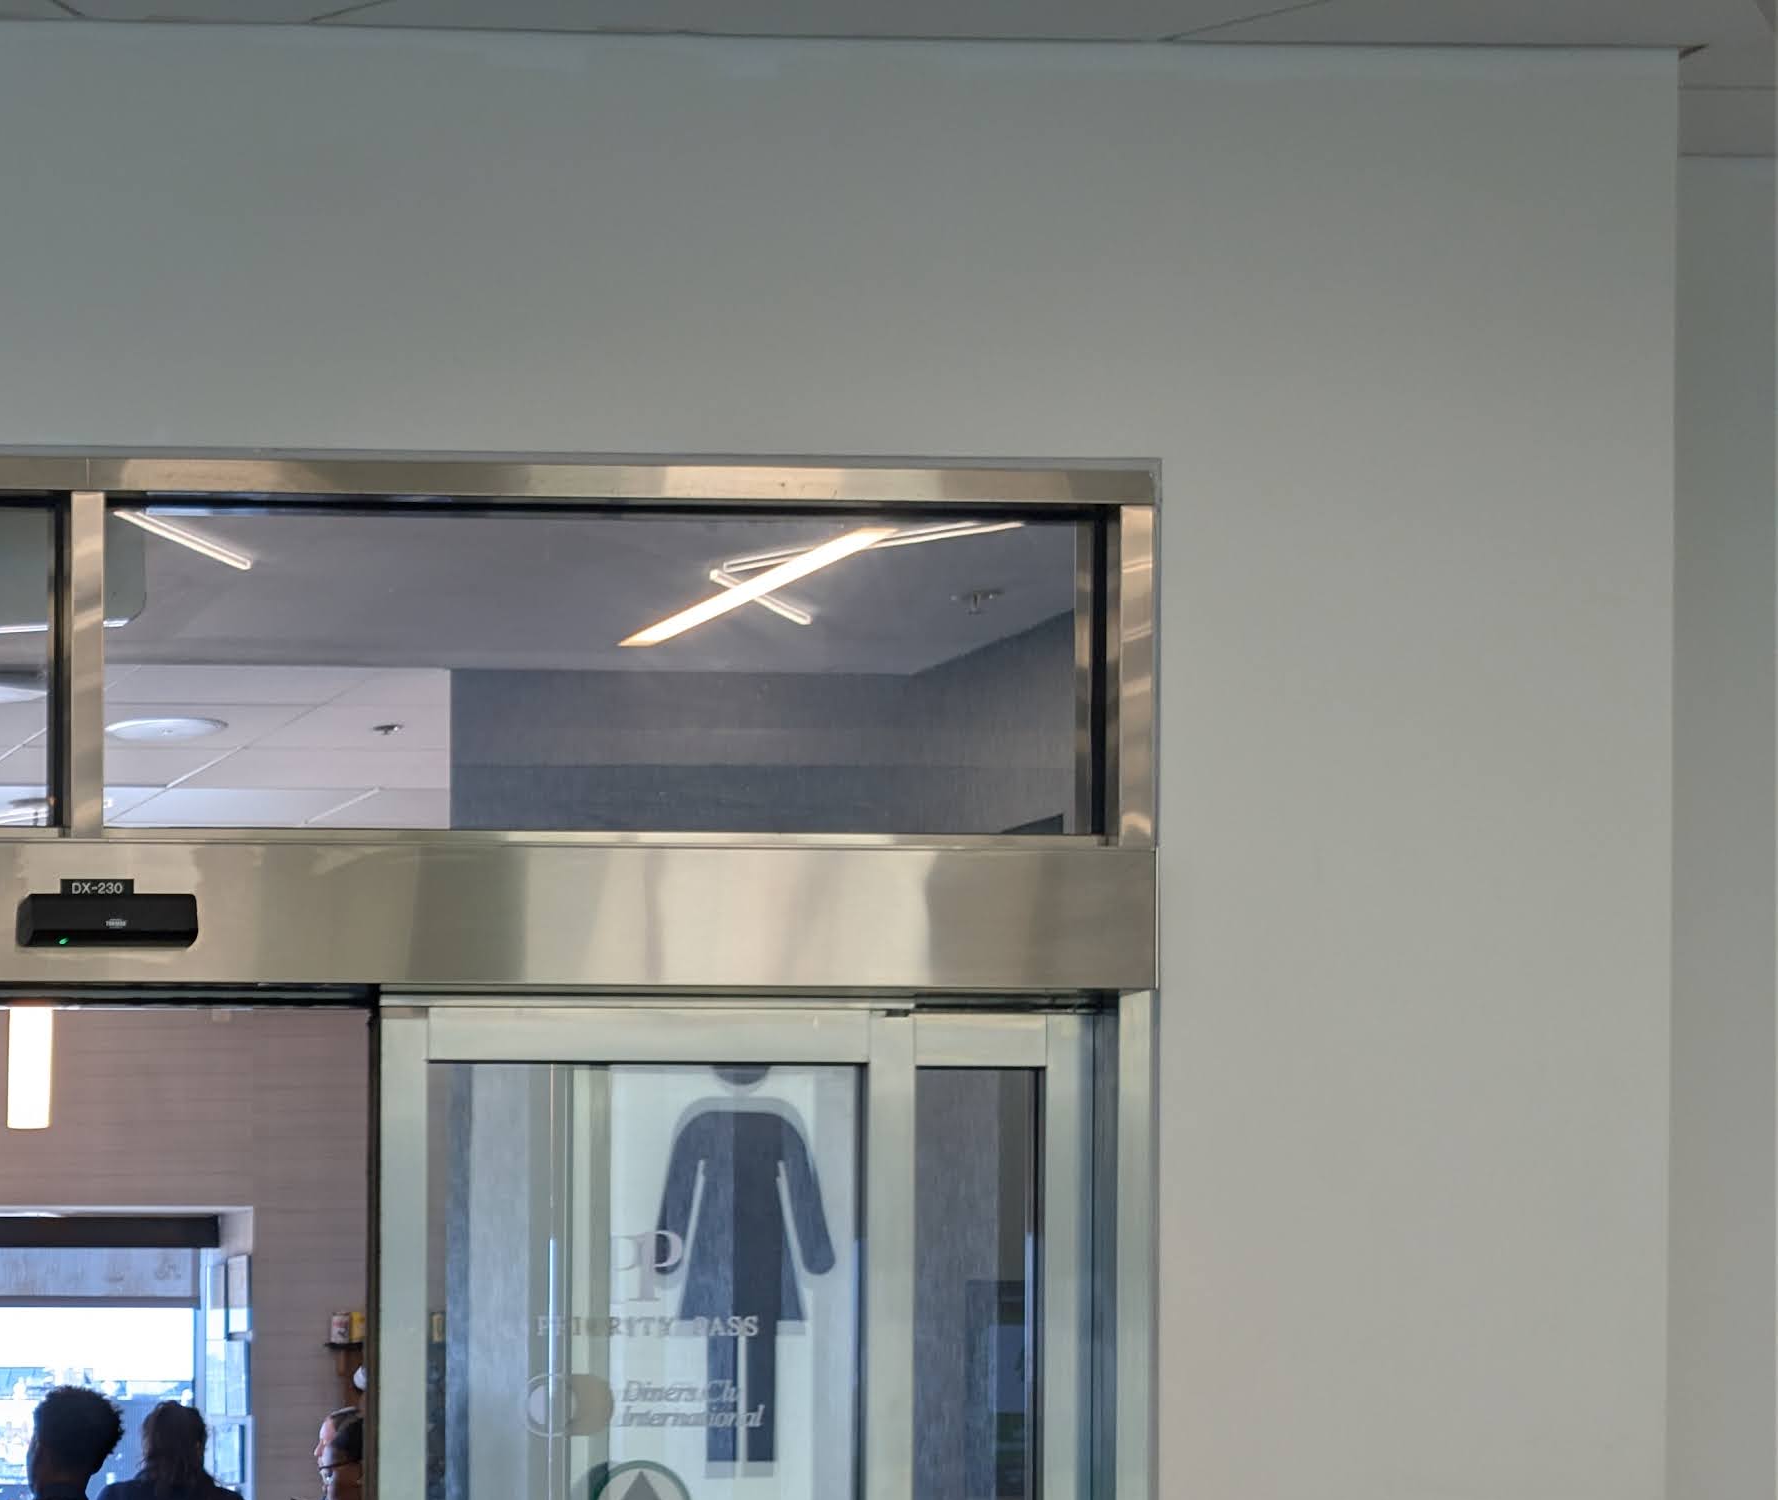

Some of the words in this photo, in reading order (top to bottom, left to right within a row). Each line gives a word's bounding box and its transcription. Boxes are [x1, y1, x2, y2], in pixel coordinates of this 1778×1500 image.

[71, 882, 123, 895] DX-230
[692, 1314, 761, 1337] PASS
[705, 1379, 746, 1403] Clu
